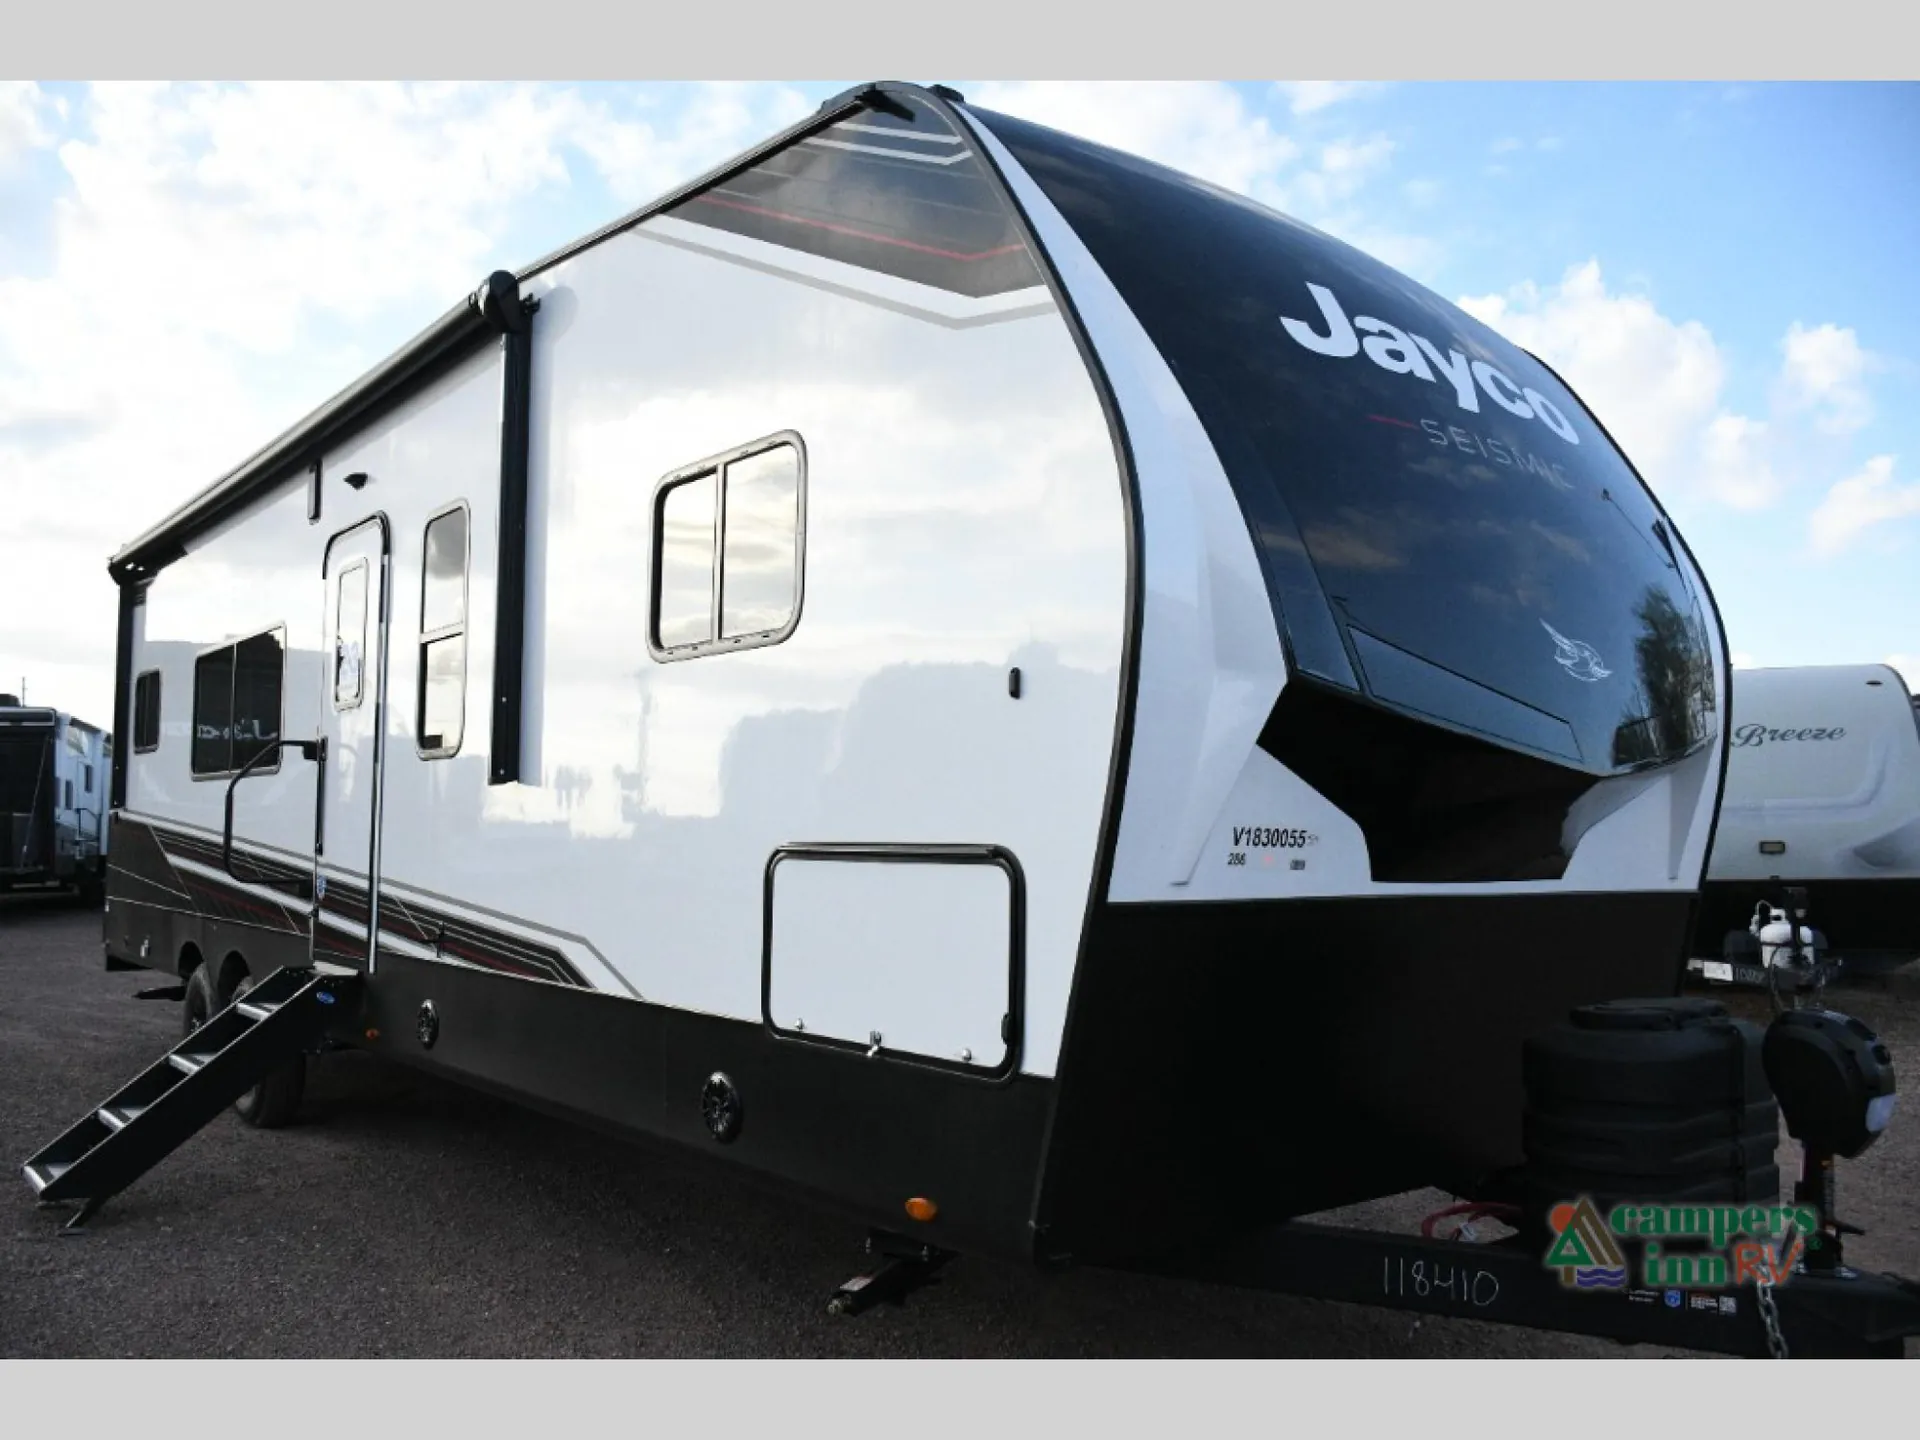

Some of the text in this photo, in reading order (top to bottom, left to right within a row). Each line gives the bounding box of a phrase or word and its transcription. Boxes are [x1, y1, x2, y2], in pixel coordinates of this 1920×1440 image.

[1280, 281, 1580, 445] Jayco
[1420, 418, 1575, 489] SEISMIC
[1731, 723, 1846, 748] Breeze
[1384, 1256, 1499, 1306] 118410
